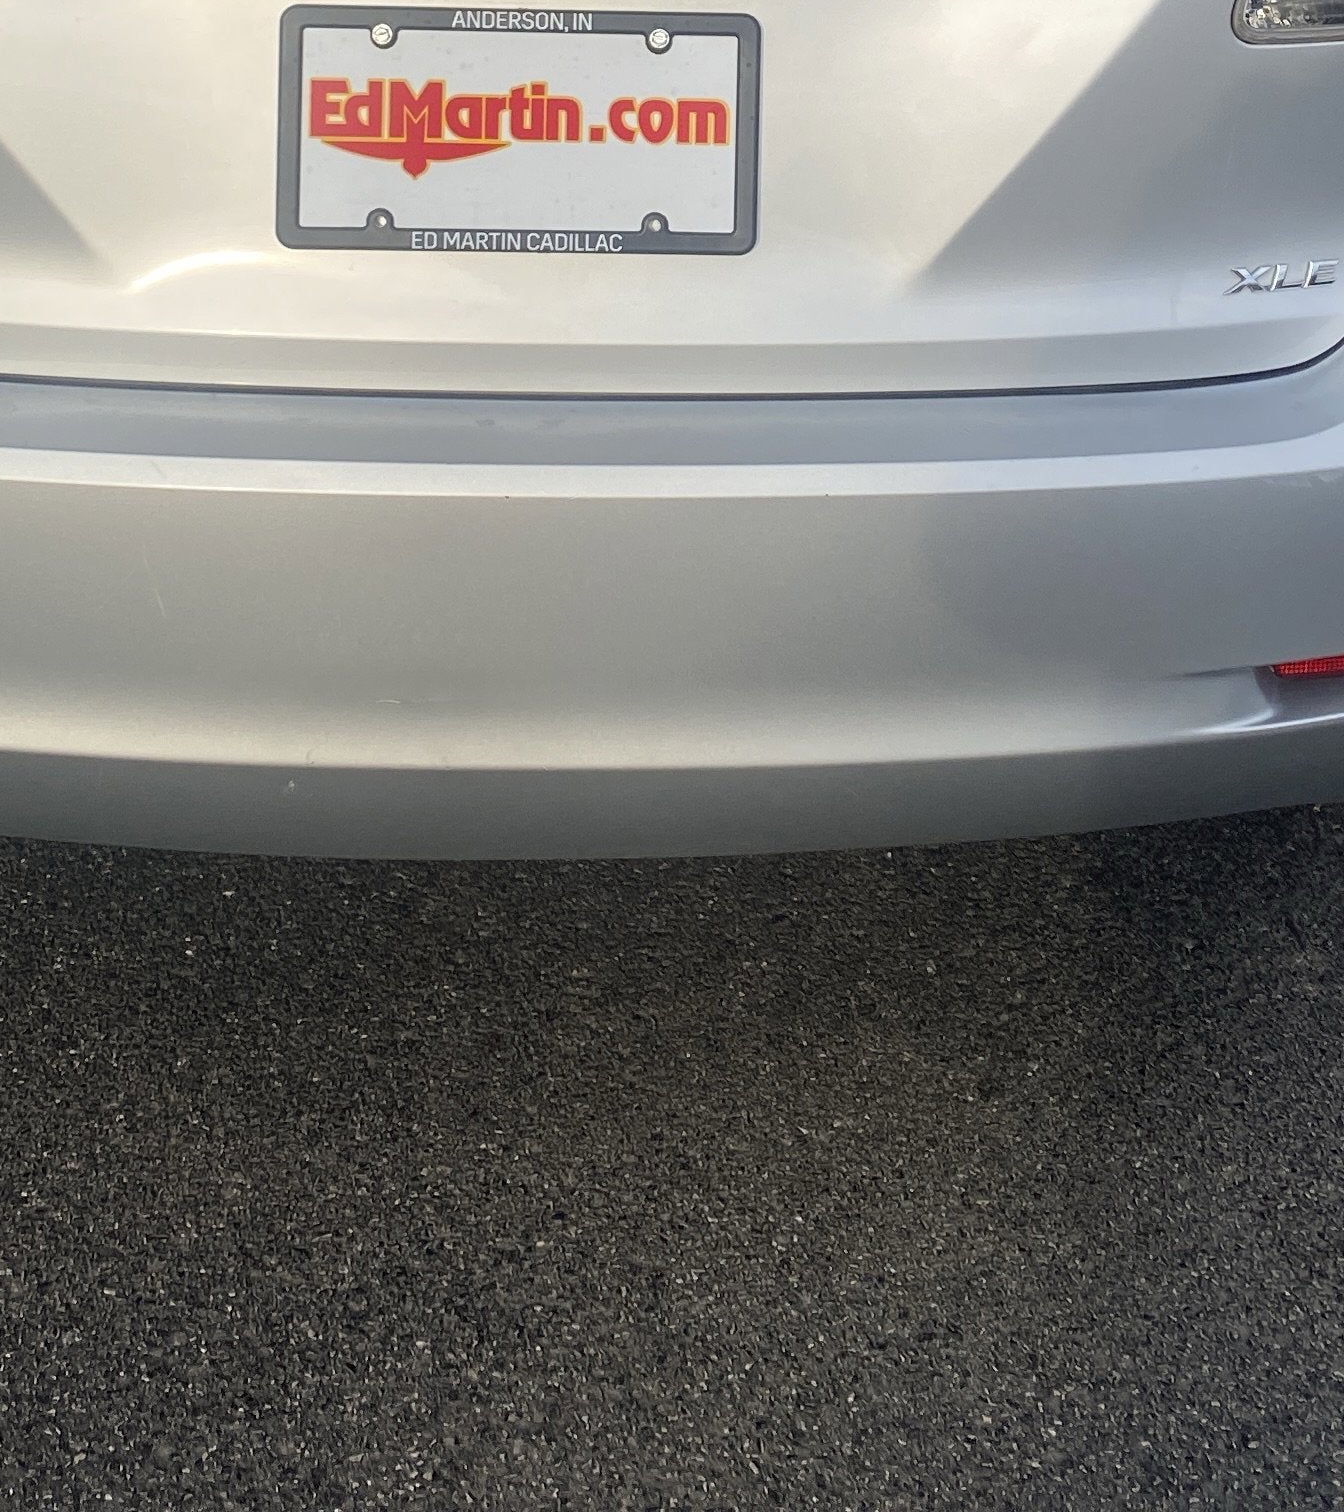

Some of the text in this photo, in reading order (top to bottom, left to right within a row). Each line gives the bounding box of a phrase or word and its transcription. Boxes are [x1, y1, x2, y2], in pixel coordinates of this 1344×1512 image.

[451, 10, 593, 33] ANDERSON, IN
[309, 78, 731, 146] EdMartin.com
[411, 232, 623, 253] ED MARTIN CADILLAC
[1222, 257, 1339, 296] XLE
